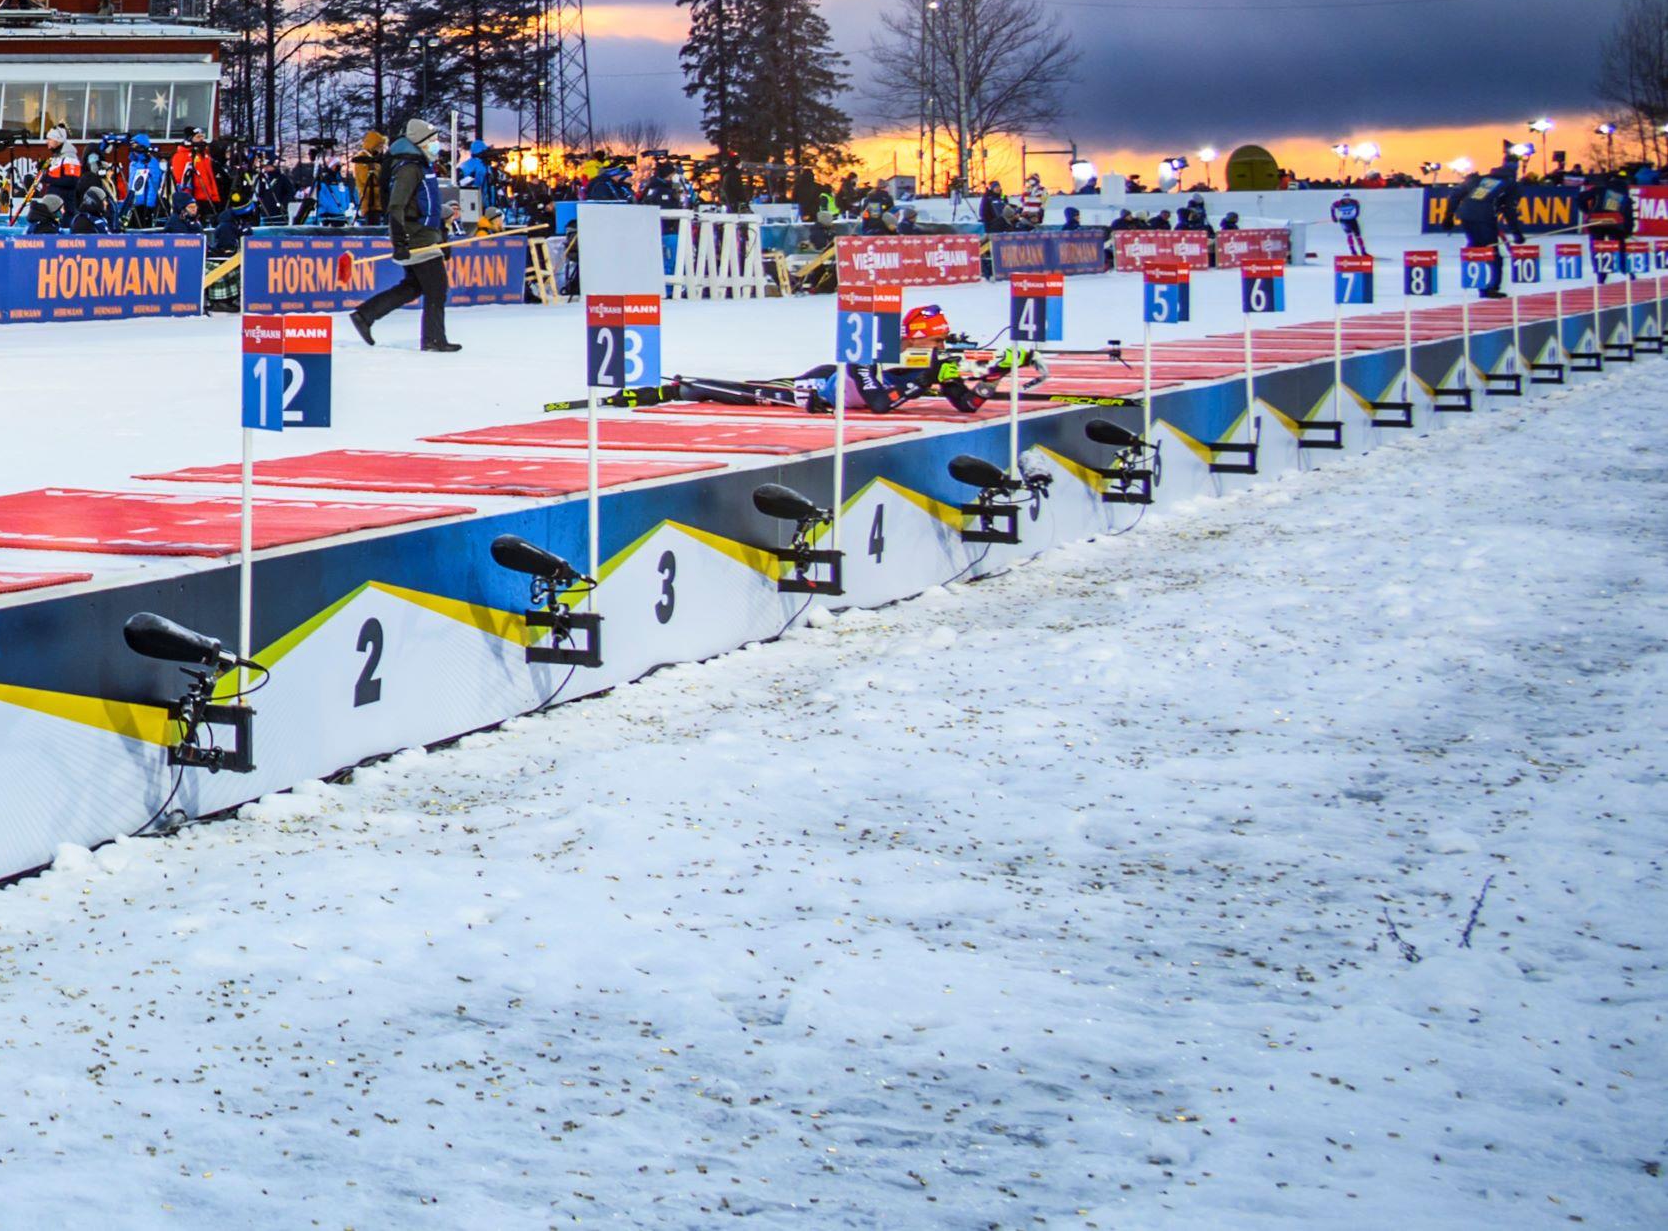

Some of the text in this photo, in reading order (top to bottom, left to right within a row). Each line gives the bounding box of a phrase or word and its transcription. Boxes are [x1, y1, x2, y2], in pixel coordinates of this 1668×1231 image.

[37, 254, 178, 299] HÖRMANN
[447, 255, 508, 288] RMANN
[1467, 261, 1480, 288] 9
[1513, 258, 1535, 282] 10
[1558, 256, 1577, 279] 11
[1594, 252, 1613, 273] 12
[1627, 252, 1645, 272] 13
[1250, 278, 1266, 312] 6
[1342, 273, 1355, 303] 7
[1411, 266, 1425, 295] 8
[1018, 297, 1037, 340] 4
[1152, 285, 1168, 322] 5
[845, 312, 863, 362] 3
[596, 327, 614, 385] 2
[253, 356, 267, 427] 1
[283, 358, 304, 422] 2
[1049, 394, 1125, 408] FISCHER
[868, 503, 884, 564] 4
[654, 550, 676, 624] 3
[354, 617, 384, 708] 2
